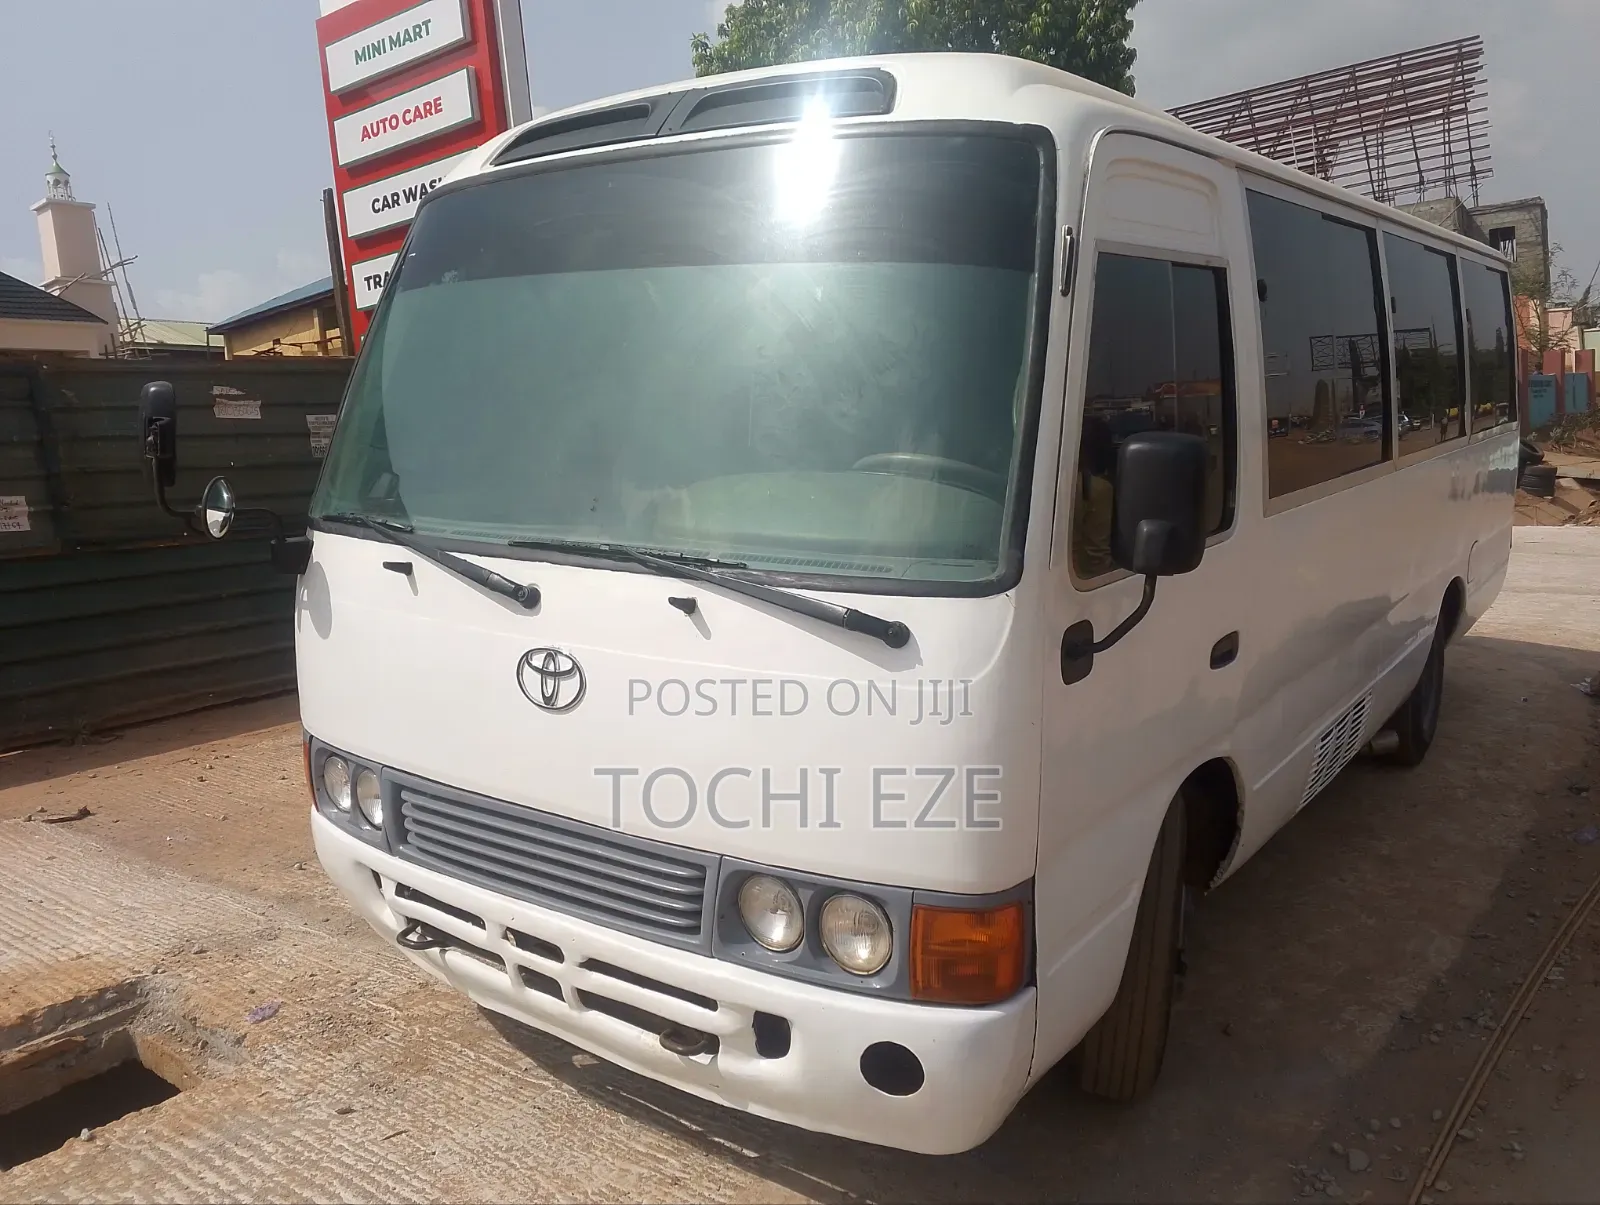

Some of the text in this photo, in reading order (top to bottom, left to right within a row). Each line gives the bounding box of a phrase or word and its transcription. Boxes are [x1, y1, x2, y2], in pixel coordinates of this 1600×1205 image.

[354, 18, 432, 65] MINI MART
[360, 96, 443, 142] AUTO CARE
[371, 176, 443, 213] CAR WAS
